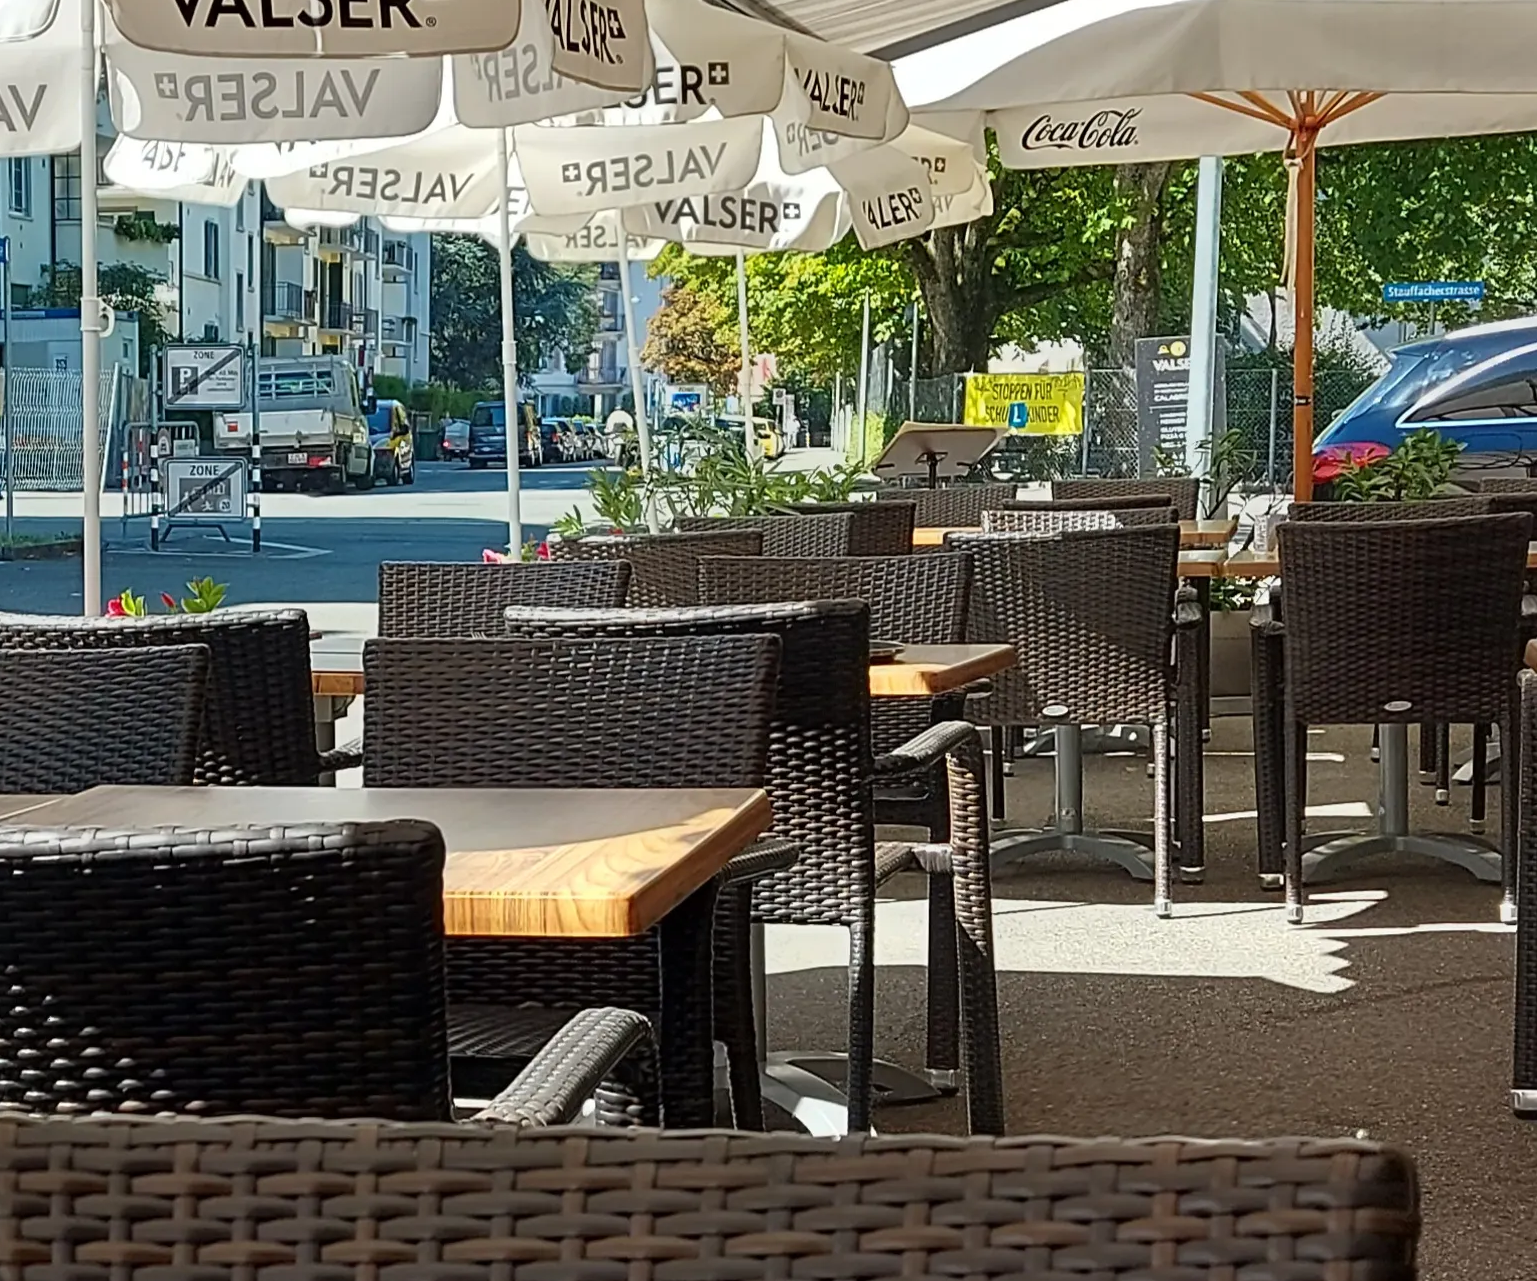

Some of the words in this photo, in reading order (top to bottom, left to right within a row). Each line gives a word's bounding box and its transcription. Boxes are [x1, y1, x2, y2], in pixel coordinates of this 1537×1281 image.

[1021, 107, 1143, 150] Coca-Cola
[655, 194, 779, 233] VALSER
[1388, 285, 1480, 298] Stauffacherstrasse
[193, 351, 215, 360] ZONE
[1152, 357, 1191, 372] VALSE
[992, 382, 1033, 400] STOPPEN
[1034, 379, 1053, 400] FÜR
[190, 465, 219, 476] ZONE
